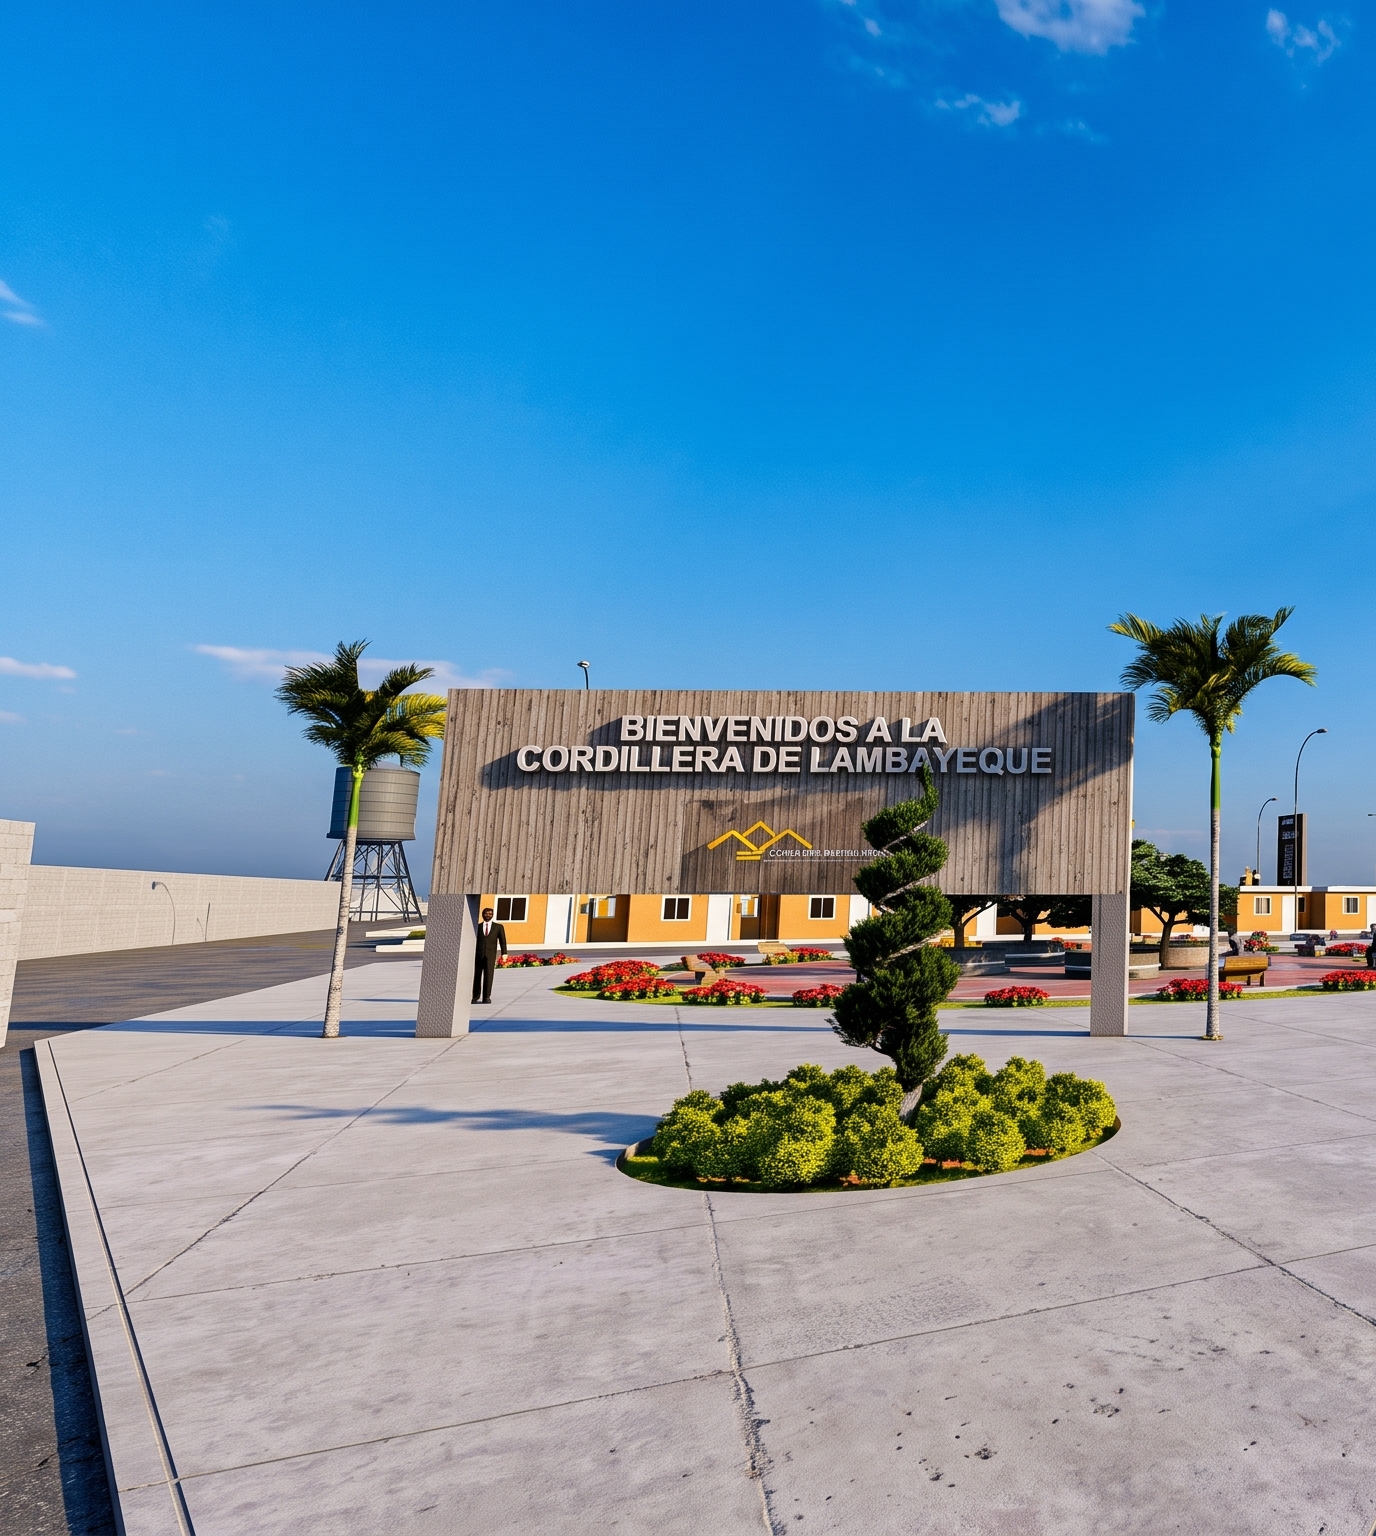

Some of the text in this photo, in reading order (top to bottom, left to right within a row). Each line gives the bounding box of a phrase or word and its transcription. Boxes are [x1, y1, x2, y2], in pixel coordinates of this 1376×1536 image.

[620, 715, 947, 743] BIENVENIDOS A LA
[516, 745, 1052, 775] CORDILLERA DE LAMBAYEQUE
